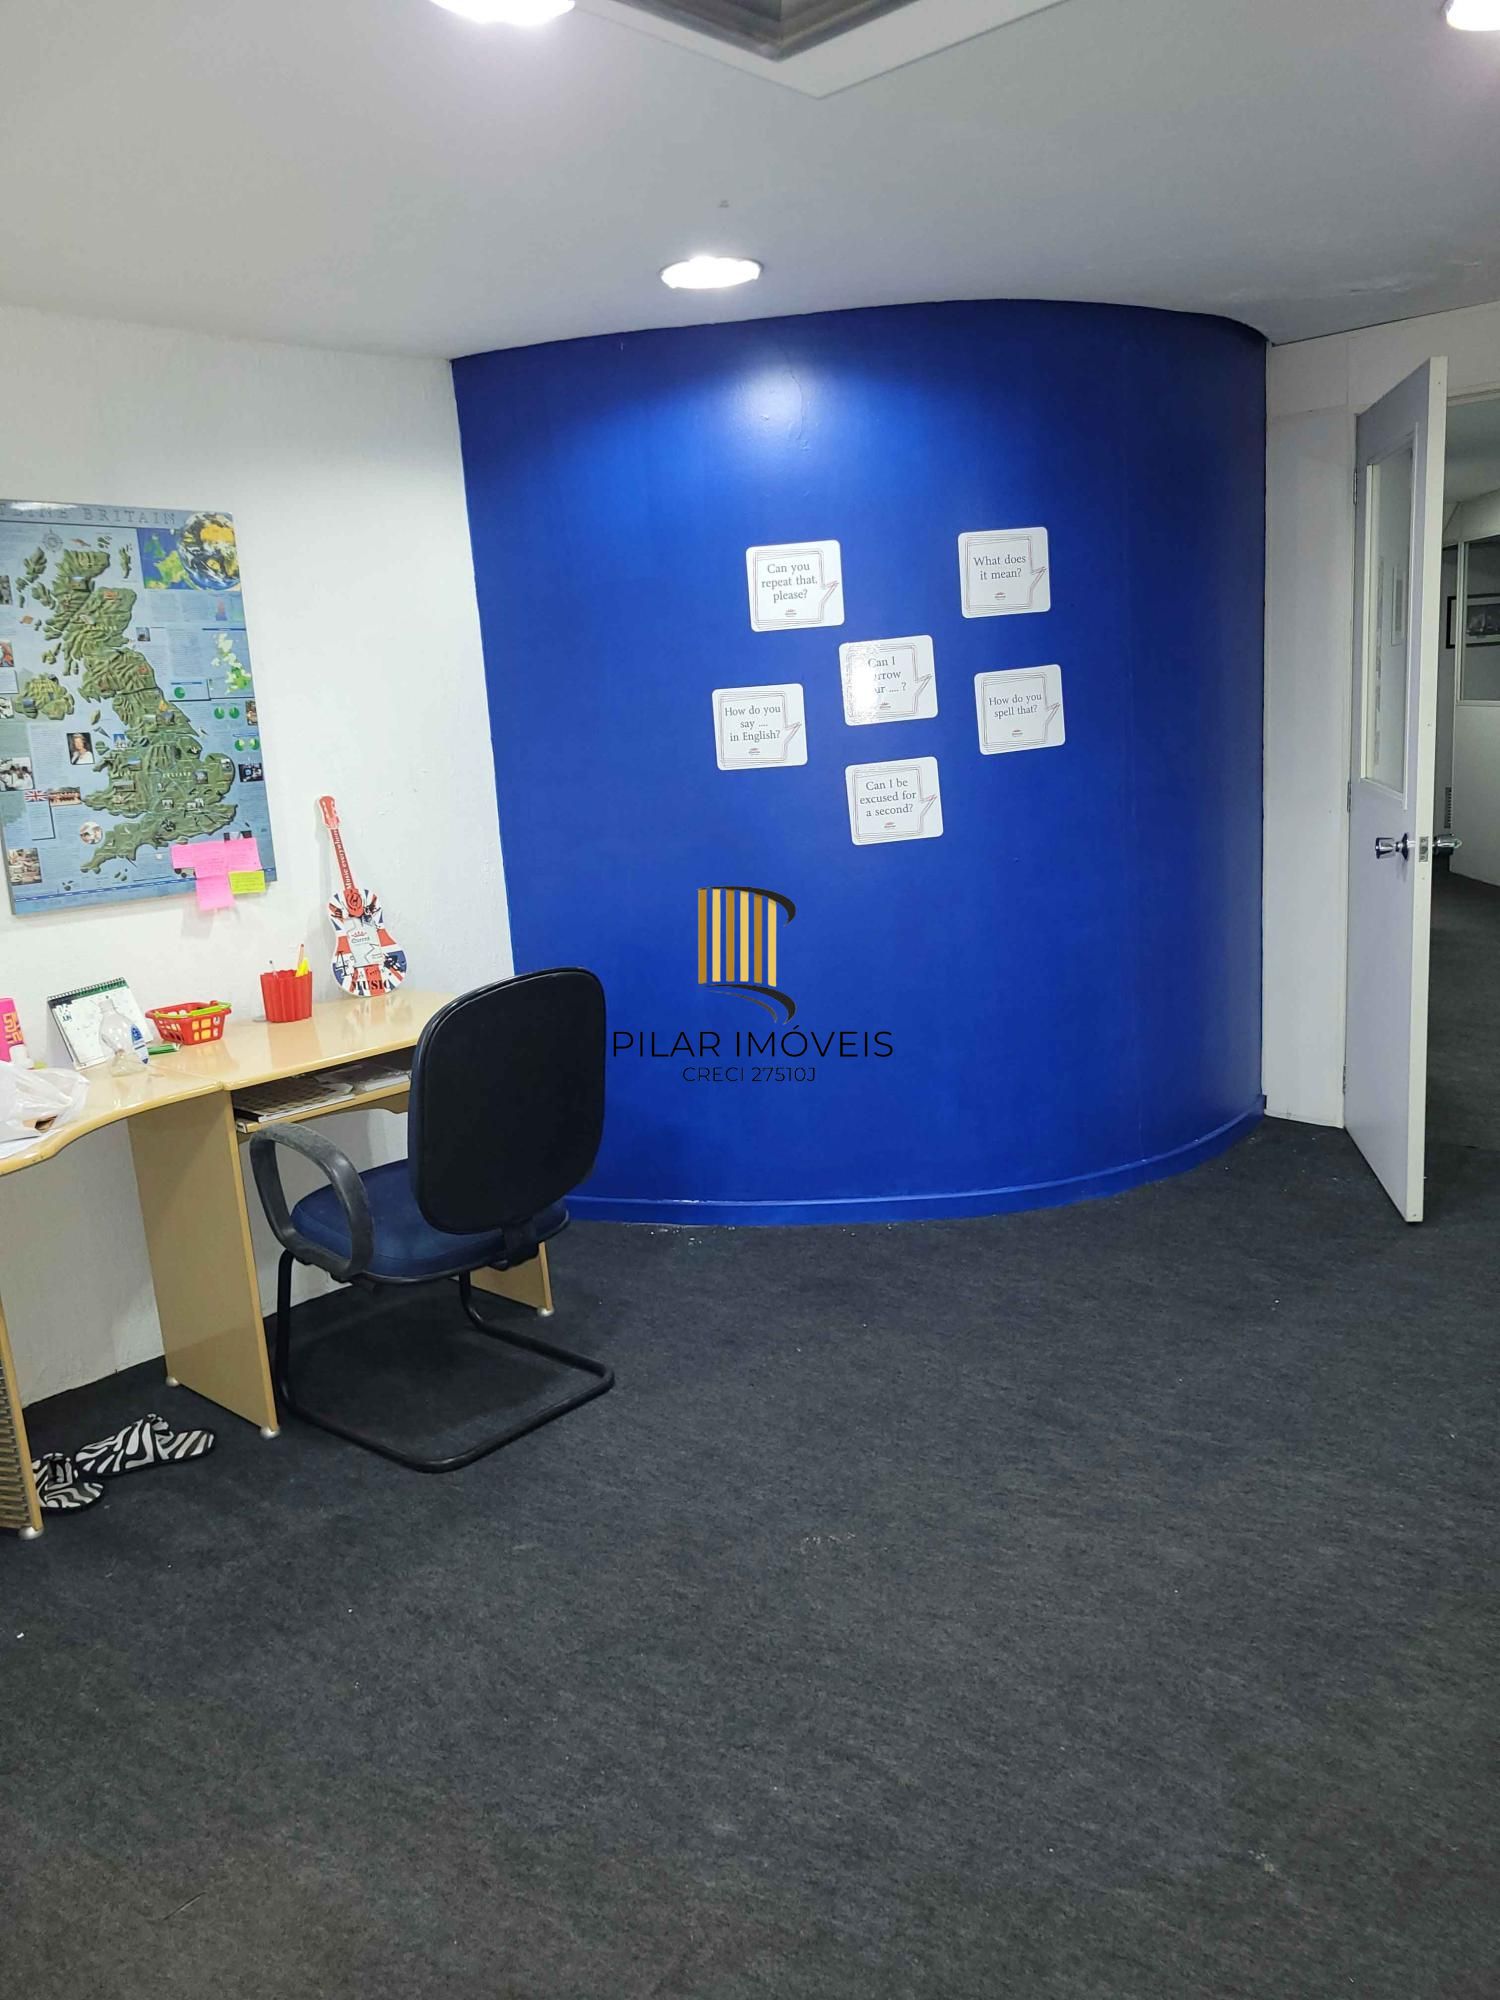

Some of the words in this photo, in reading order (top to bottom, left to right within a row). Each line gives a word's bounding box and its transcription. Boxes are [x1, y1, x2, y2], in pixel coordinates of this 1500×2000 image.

[973, 555, 1001, 566] What
[1004, 554, 1026, 564] does
[767, 563, 788, 574] Can
[790, 562, 810, 575] you
[980, 570, 988, 581] it
[991, 567, 1022, 580] mean?
[761, 577, 792, 590] repeat
[773, 588, 808, 604] please?
[868, 658, 888, 668] Can
[892, 656, 896, 666] I
[988, 696, 1010, 706] How
[1011, 693, 1024, 704] do
[1026, 693, 1042, 704] you
[725, 706, 746, 717] How
[748, 704, 761, 715] do
[763, 705, 781, 717] you
[994, 706, 1015, 720] spell
[1017, 704, 1038, 715] that?
[740, 720, 755, 731] say
[729, 732, 739, 742] in
[742, 729, 781, 744] English?
[865, 780, 887, 791] Can
[889, 779, 893, 789] I
[896, 778, 909, 788] be
[860, 791, 899, 805] excused
[902, 790, 917, 800] for
[875, 803, 914, 817] second?
